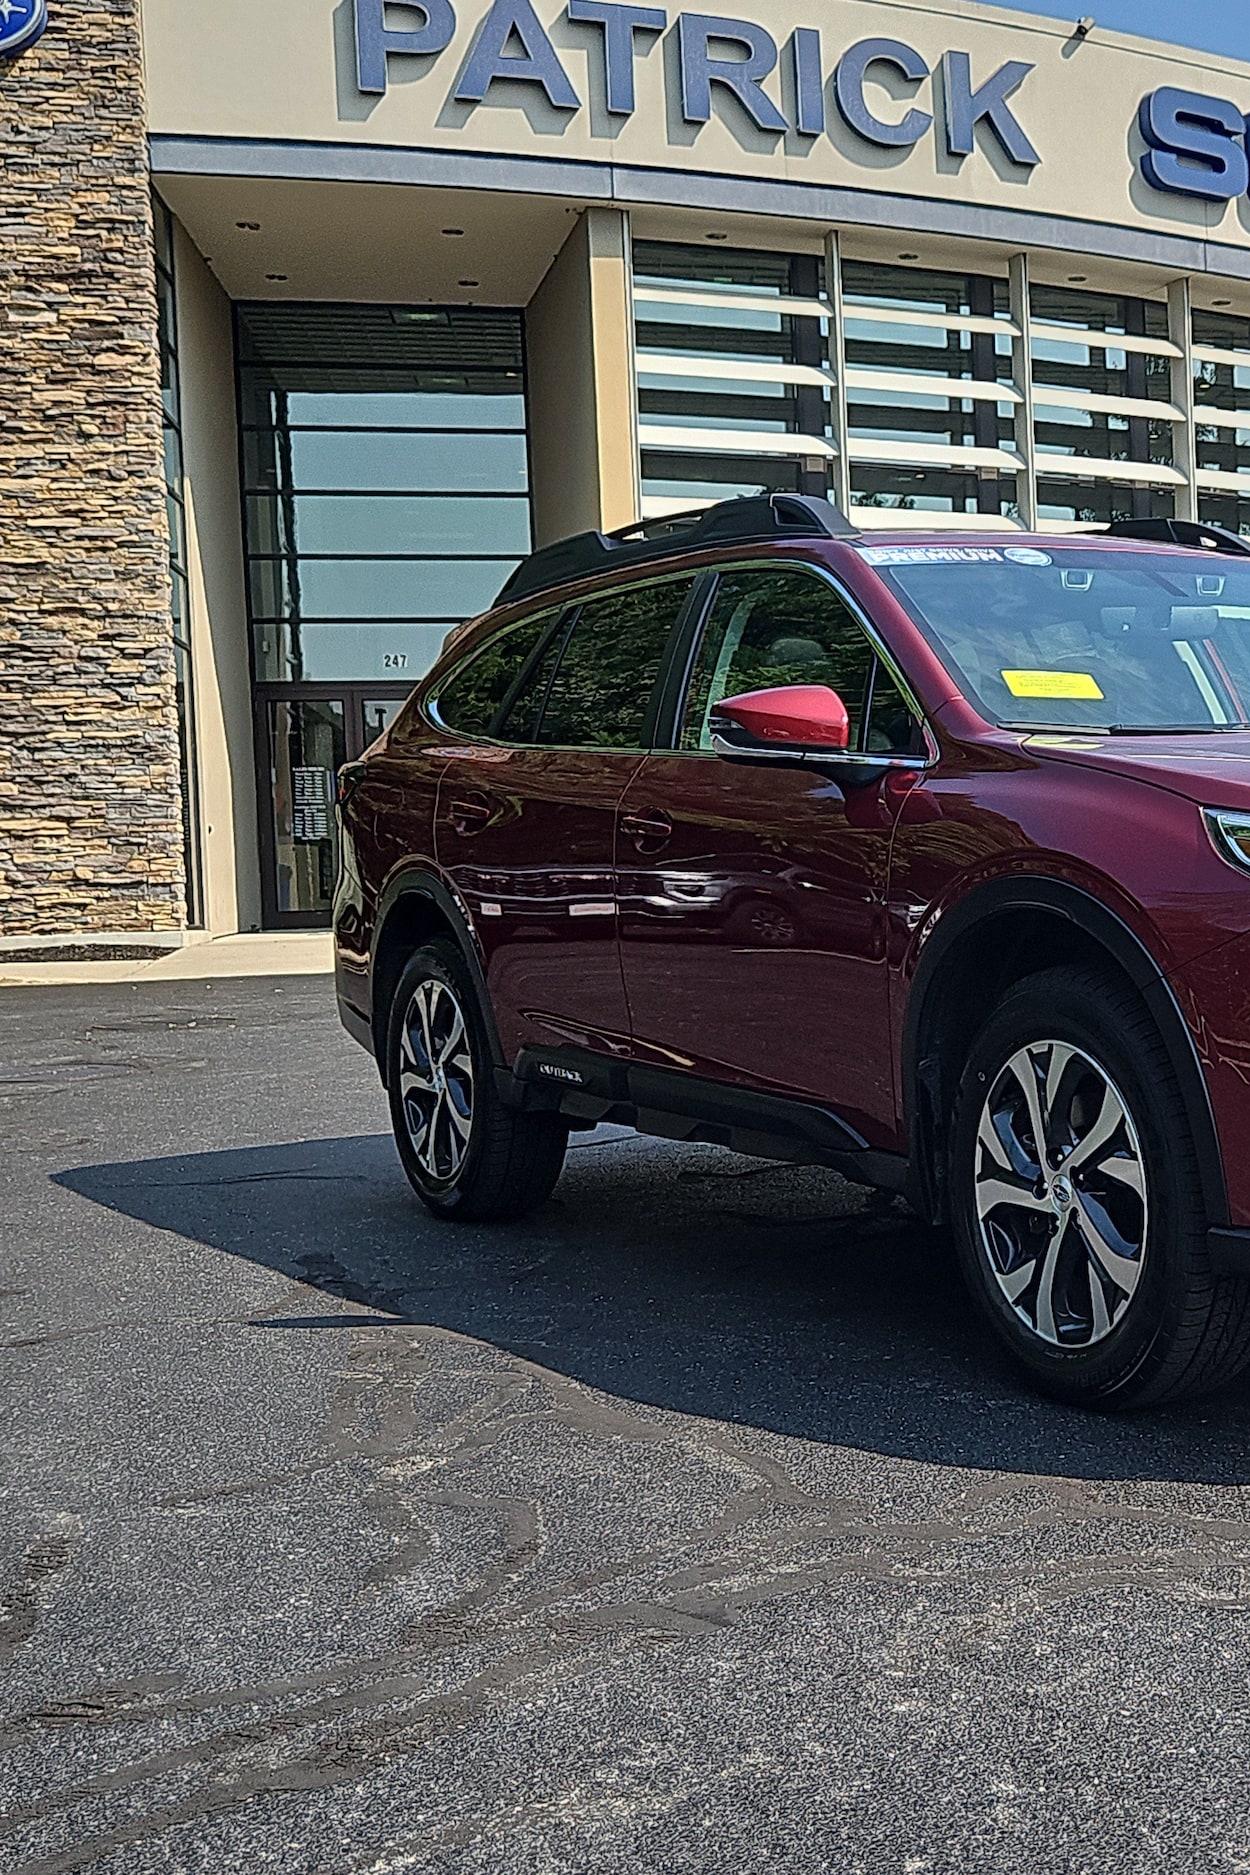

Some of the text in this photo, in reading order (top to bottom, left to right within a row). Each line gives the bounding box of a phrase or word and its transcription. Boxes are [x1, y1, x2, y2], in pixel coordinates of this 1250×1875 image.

[355, 0, 1043, 167] PATRICK
[869, 549, 1004, 562] PREMIUM
[384, 654, 407, 668] 247
[540, 1063, 583, 1083] OUTBACK
